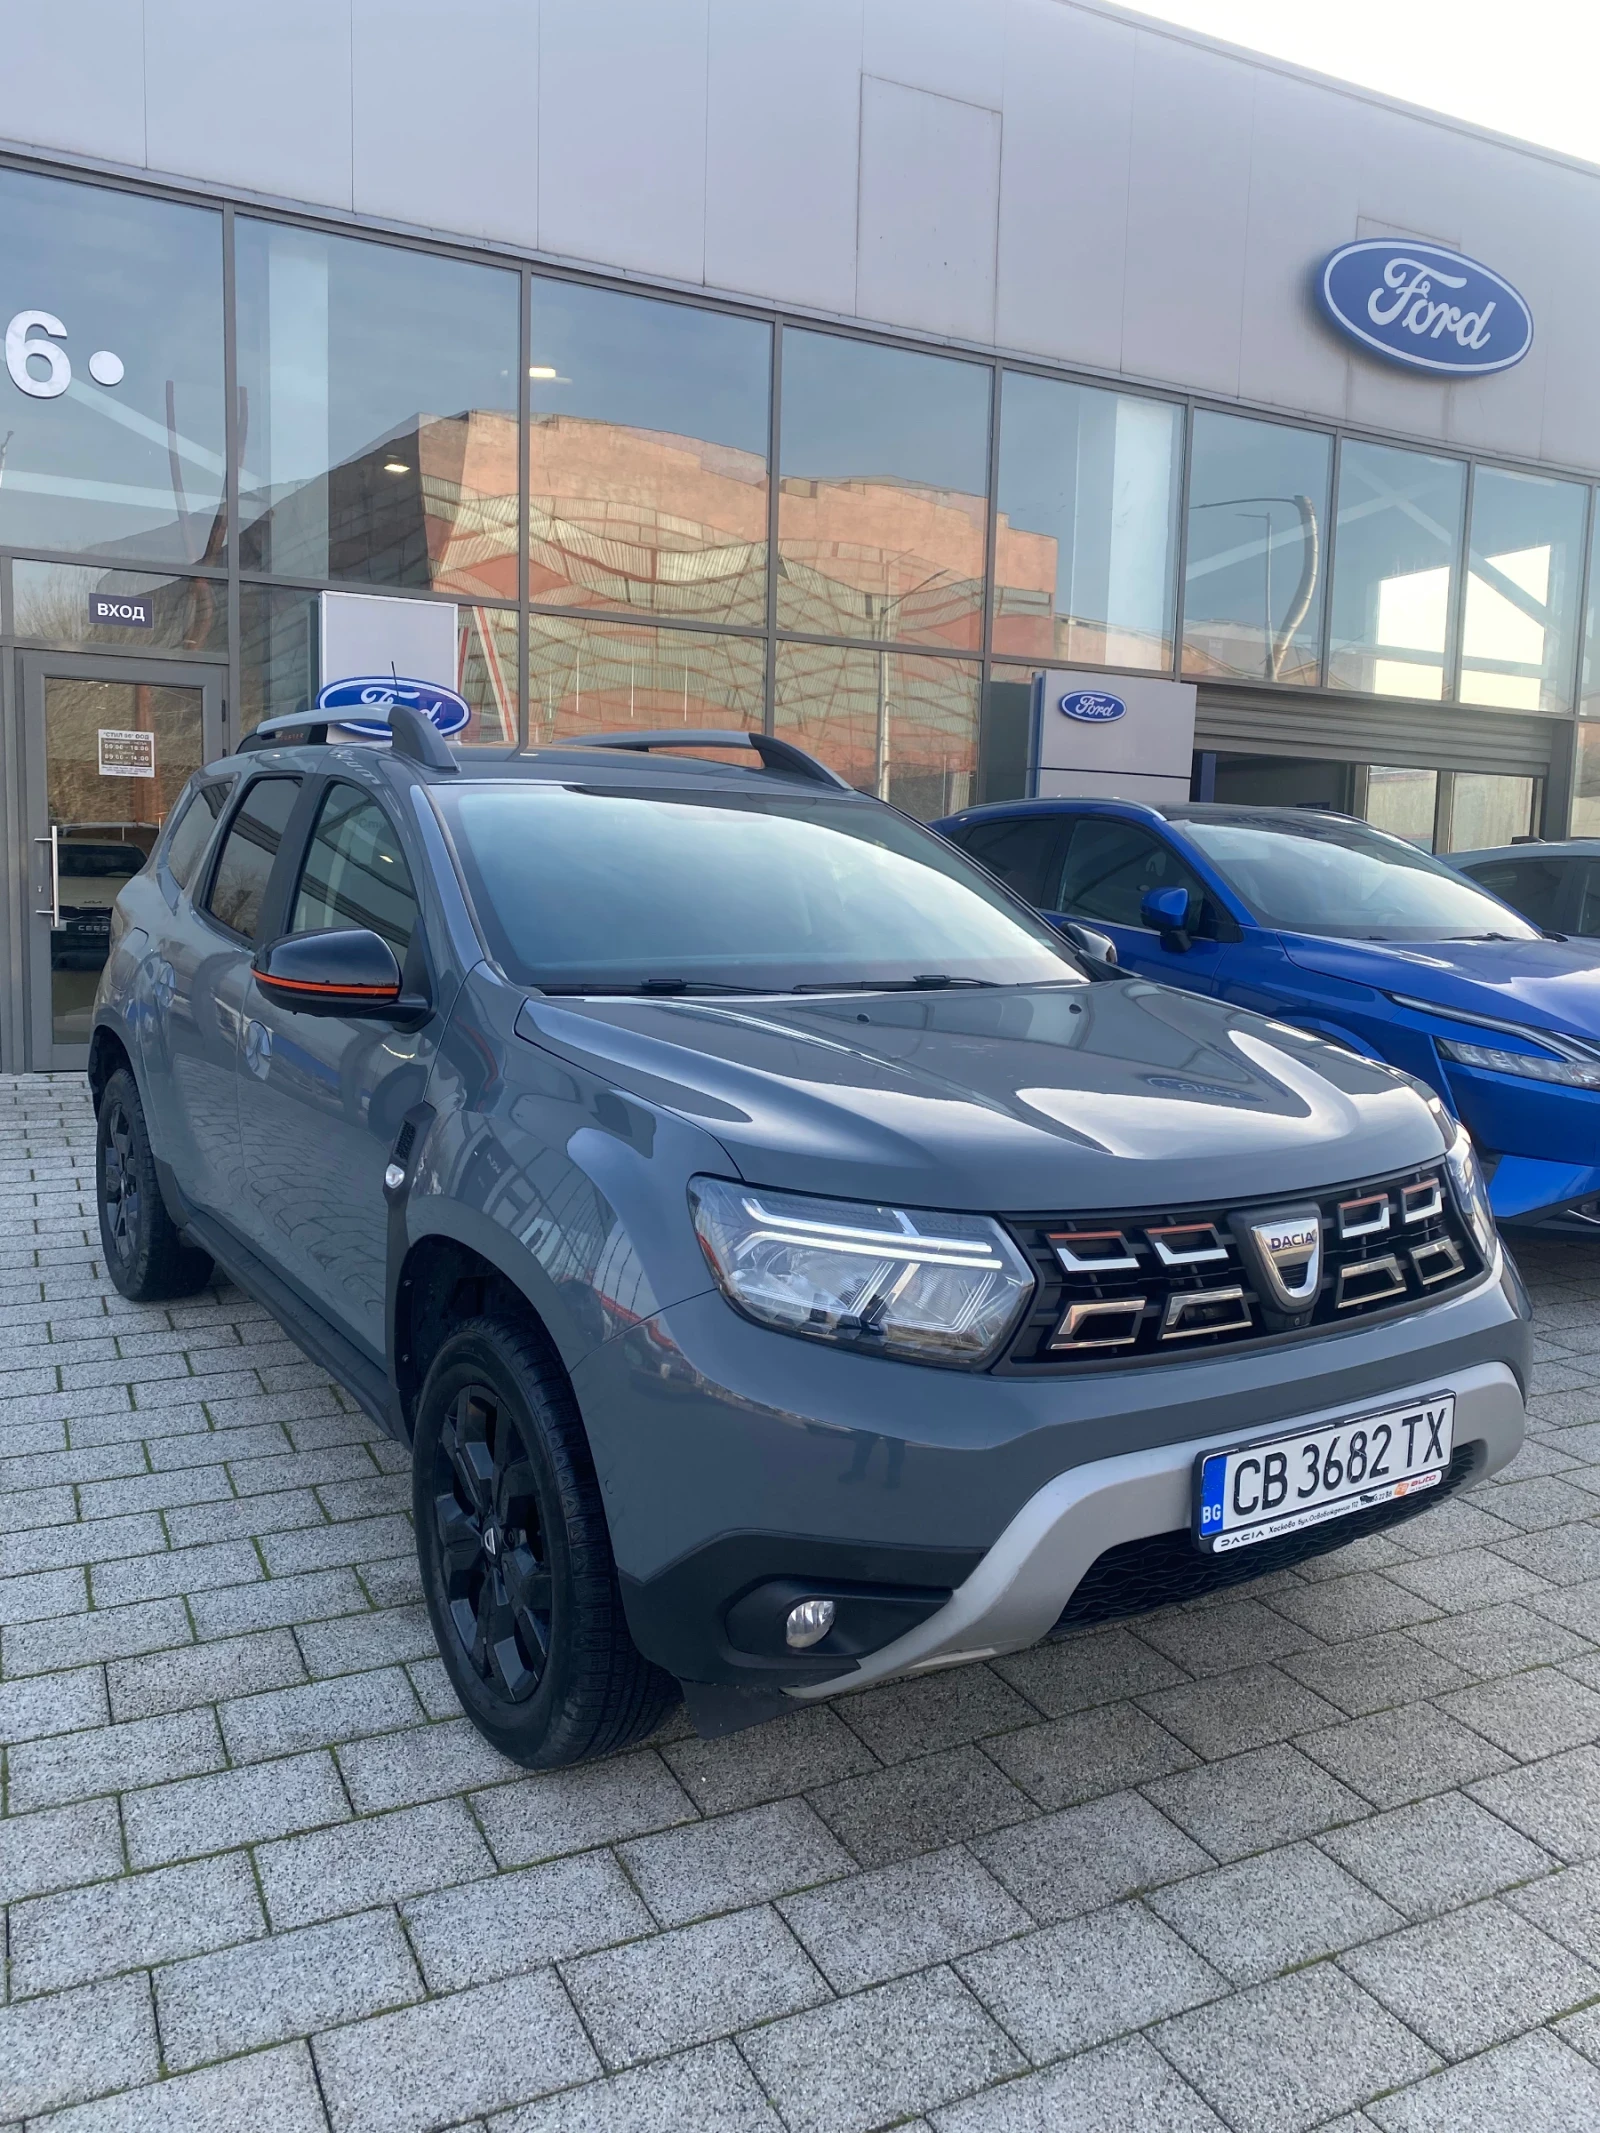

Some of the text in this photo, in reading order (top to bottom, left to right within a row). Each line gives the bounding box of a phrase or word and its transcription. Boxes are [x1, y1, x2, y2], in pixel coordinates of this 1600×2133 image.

[1367, 257, 1497, 350] Ford
[97, 602, 146, 622] ВХОД
[1075, 695, 1115, 717] Ford
[1270, 1231, 1315, 1250] DACIA
[1233, 1407, 1447, 1516] CB 3682 TX
[1203, 1504, 1221, 1524] BG
[1220, 1530, 1264, 1547] DACIA
